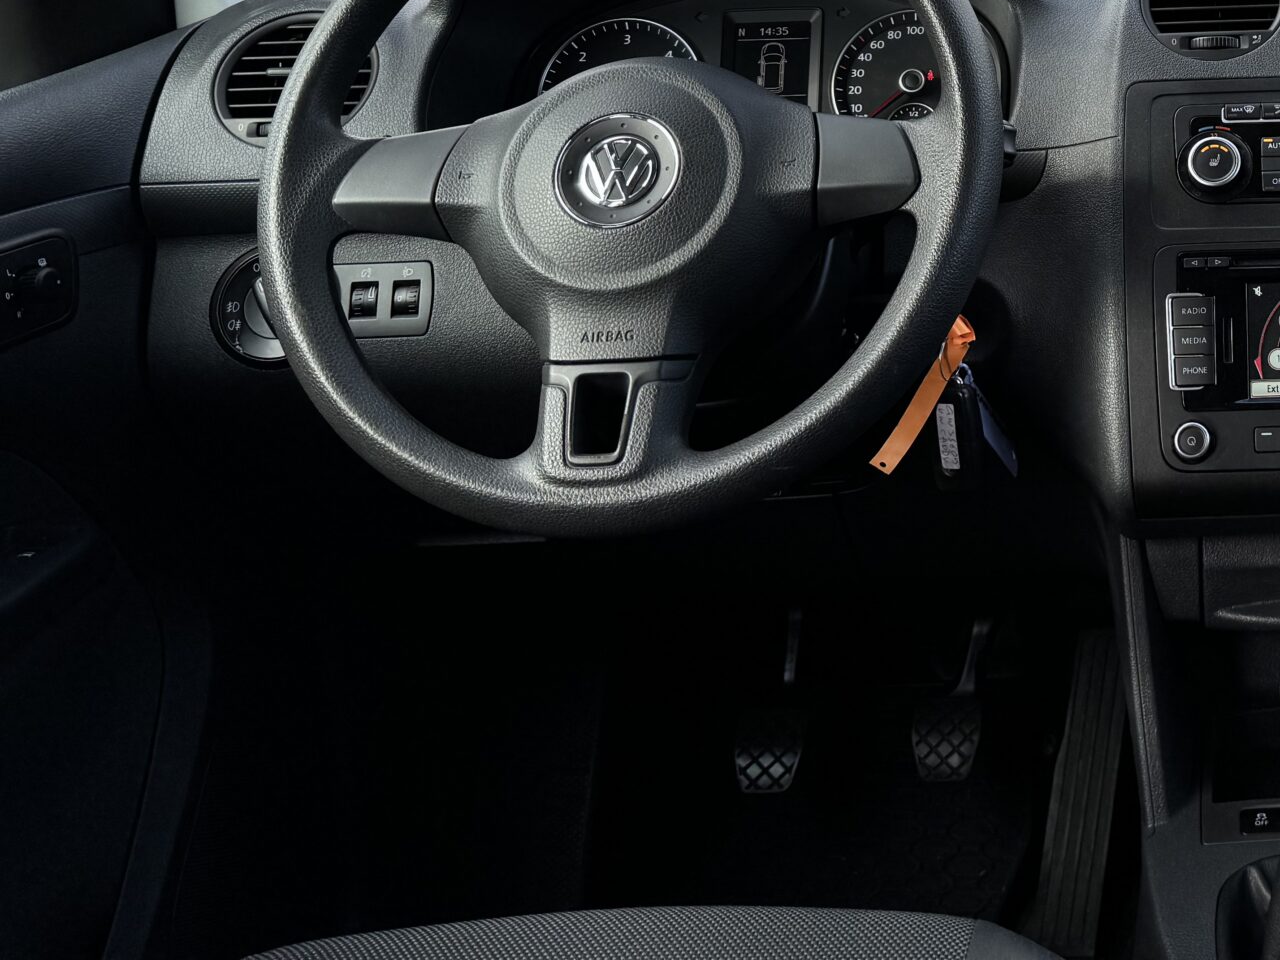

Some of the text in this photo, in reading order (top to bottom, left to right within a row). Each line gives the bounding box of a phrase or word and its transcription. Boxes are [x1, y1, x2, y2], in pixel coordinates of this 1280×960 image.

[738, 27, 746, 37] N
[759, 26, 789, 37] 14:35
[887, 30, 902, 39] 80
[906, 26, 925, 35] 100
[623, 34, 632, 45] 3
[869, 40, 885, 49] 60
[578, 51, 587, 62] 2
[857, 53, 872, 61] 40
[851, 68, 865, 78] 30
[848, 85, 862, 95] 20
[850, 103, 863, 113] 10
[1181, 307, 1207, 315] RADIO
[580, 330, 635, 343] AIRBAG
[1181, 337, 1207, 345] MEDIA
[1182, 367, 1208, 375] PHONE
